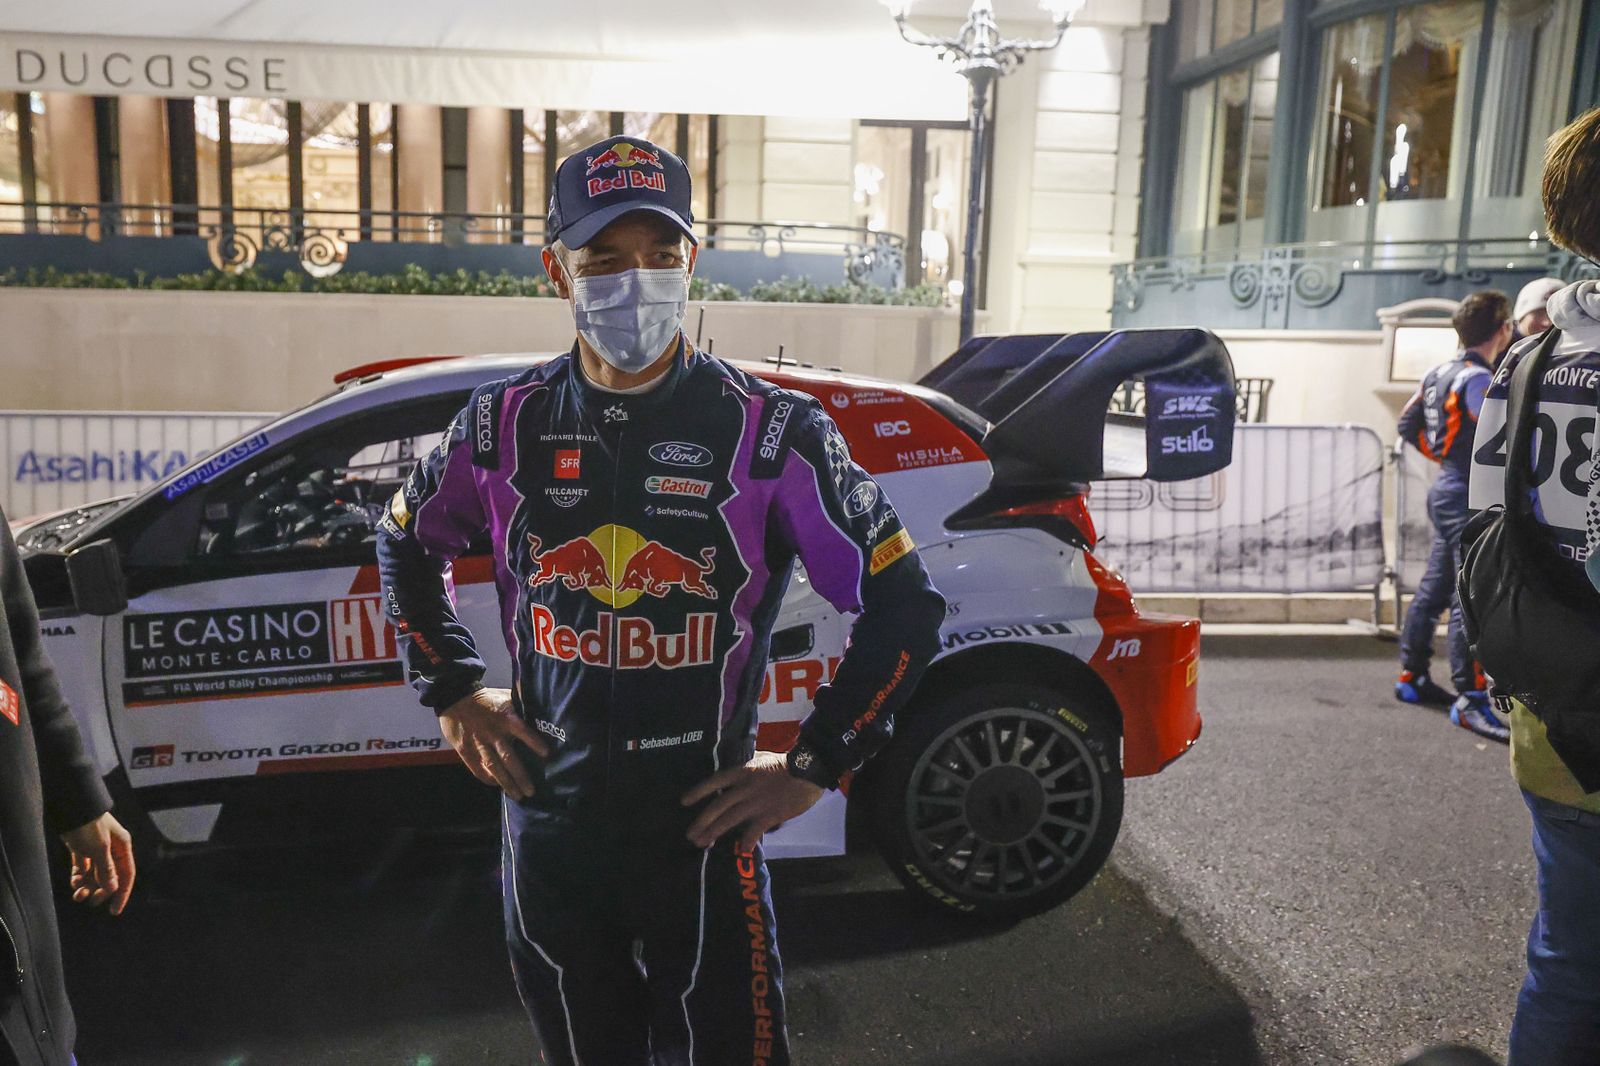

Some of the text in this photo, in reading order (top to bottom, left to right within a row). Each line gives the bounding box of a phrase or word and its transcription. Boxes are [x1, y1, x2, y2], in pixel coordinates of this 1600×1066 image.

[588, 169, 666, 198] Red Bull
[477, 393, 493, 453] sparco
[759, 401, 794, 461] sparco
[540, 433, 598, 442] RICHARD MILLE
[1161, 425, 1214, 454] Stilo
[560, 458, 579, 470] SFR
[660, 443, 702, 464] Ford
[897, 446, 962, 463] NISULA
[15, 450, 210, 482] AsahiKA
[544, 487, 589, 496] VULCANET
[660, 478, 707, 496] Castrol
[656, 507, 709, 520] SafetyCulture
[387, 585, 401, 616] FORD
[129, 609, 320, 649] LE CASINO
[531, 602, 718, 670] Red Bull
[1107, 639, 1141, 660] JTB
[173, 683, 191, 693] FIA
[194, 681, 225, 692] World
[228, 679, 255, 691] Rally
[257, 674, 333, 687] Championship
[181, 747, 272, 764] TOYOTA
[366, 736, 441, 751] Racing
[640, 730, 704, 750] Sebastien LOEB
[735, 841, 774, 1066] PERFORMANC
